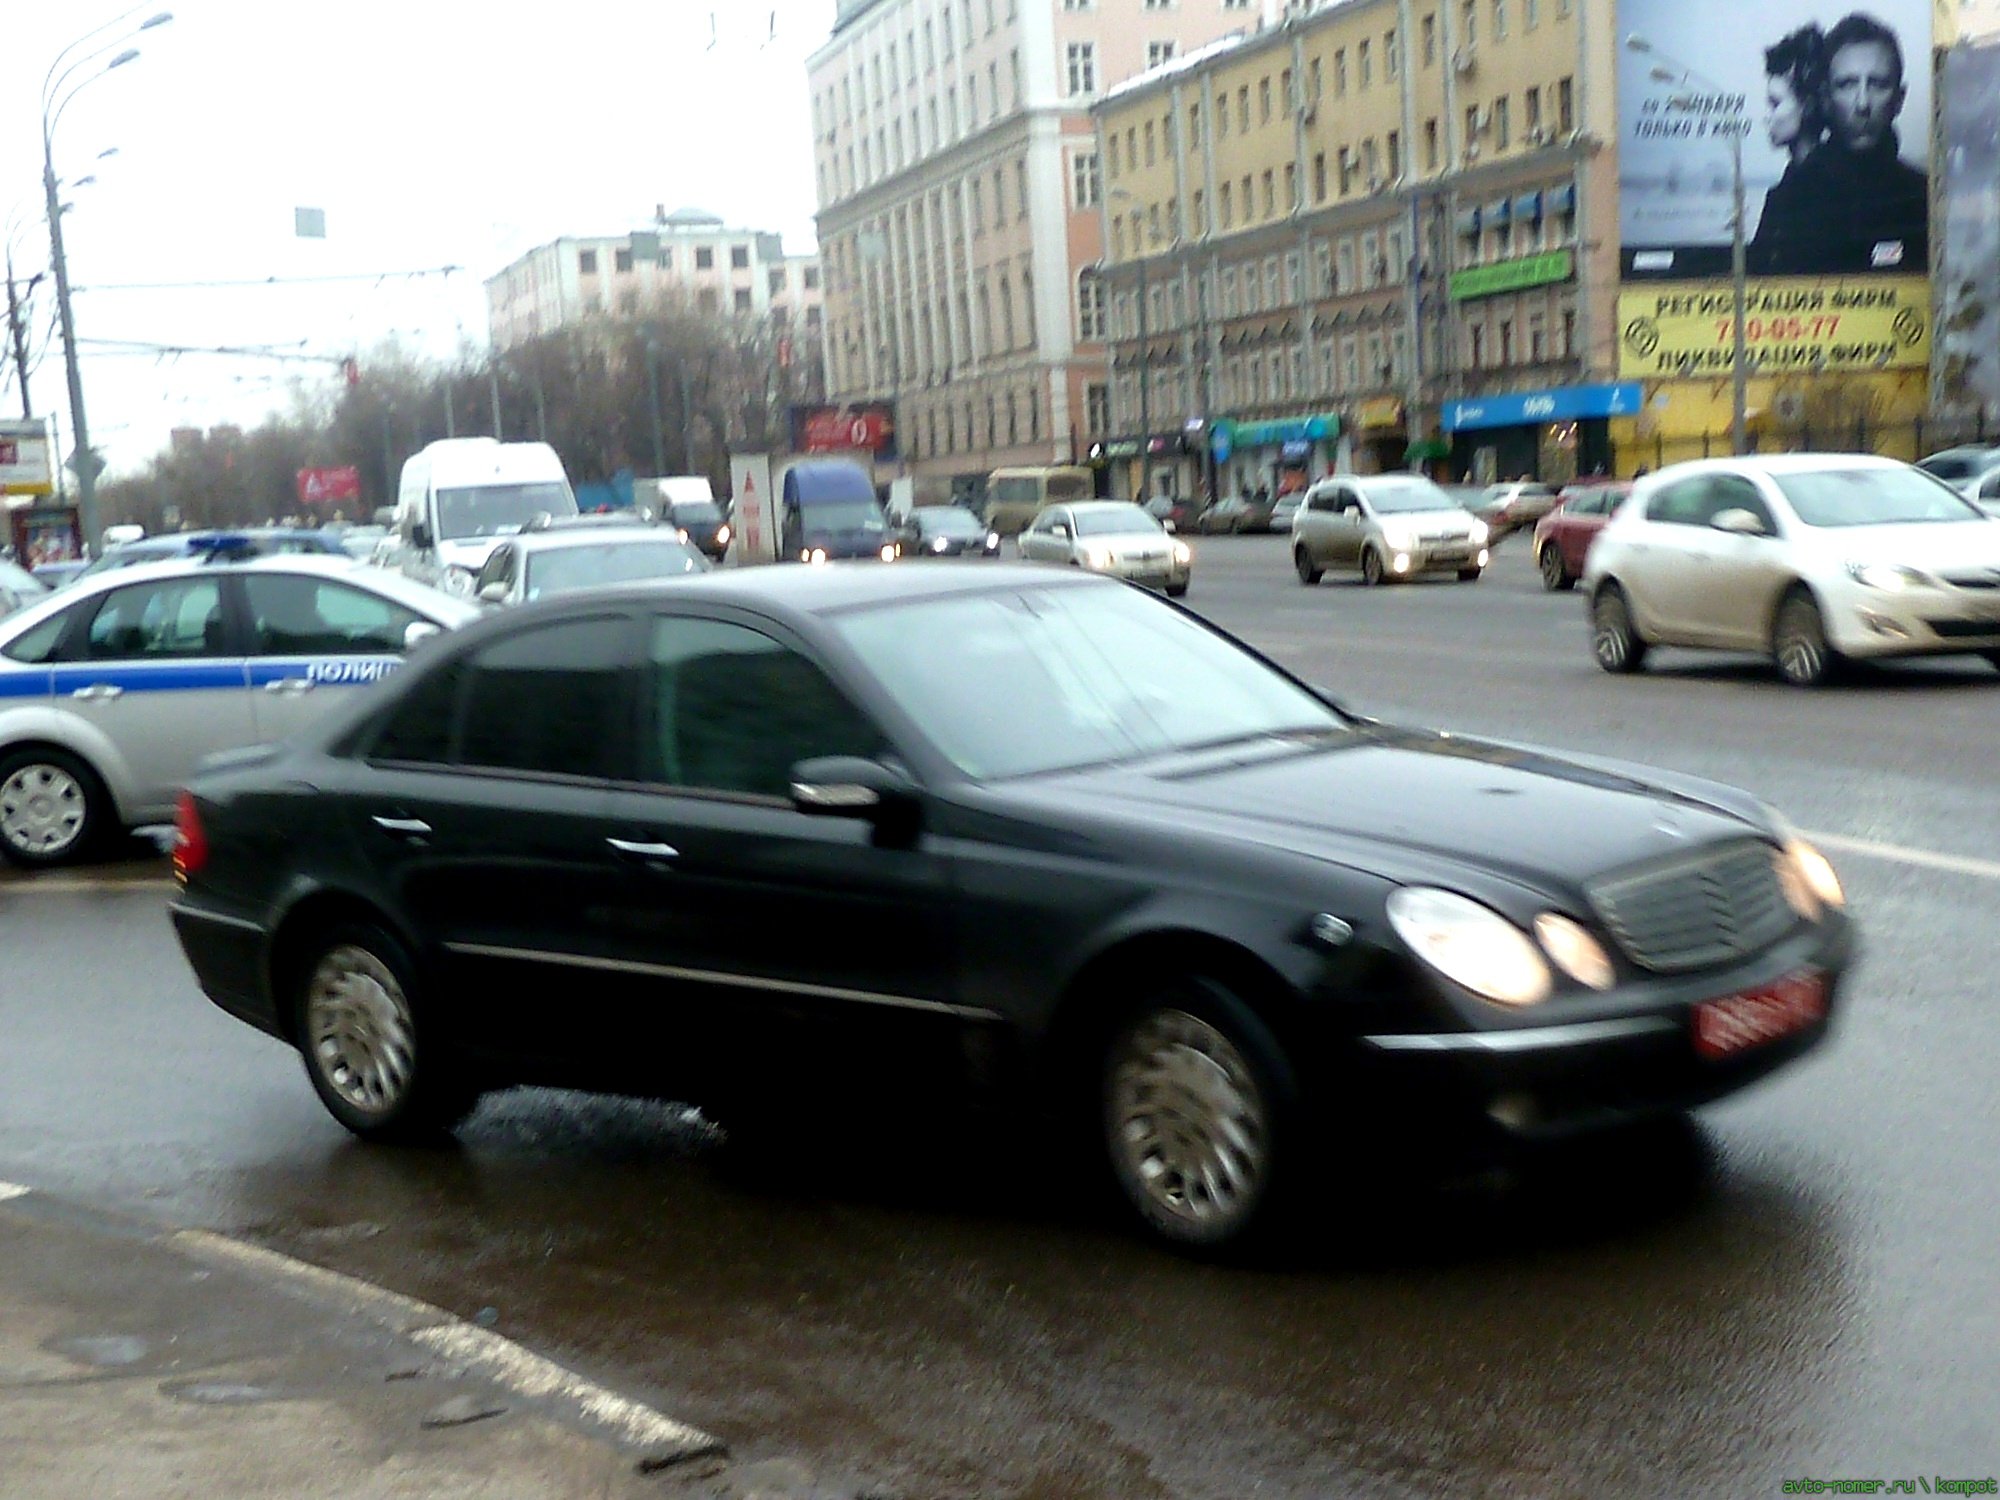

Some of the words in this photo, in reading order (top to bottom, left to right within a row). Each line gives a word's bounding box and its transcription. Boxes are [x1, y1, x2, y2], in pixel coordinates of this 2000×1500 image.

[1656, 290, 1823, 318] РЕГИСРАЦИЯ
[1830, 288, 1897, 309] ФИРМ
[1715, 314, 1841, 343] 70-05-77
[1829, 341, 1897, 364] ФИРМ
